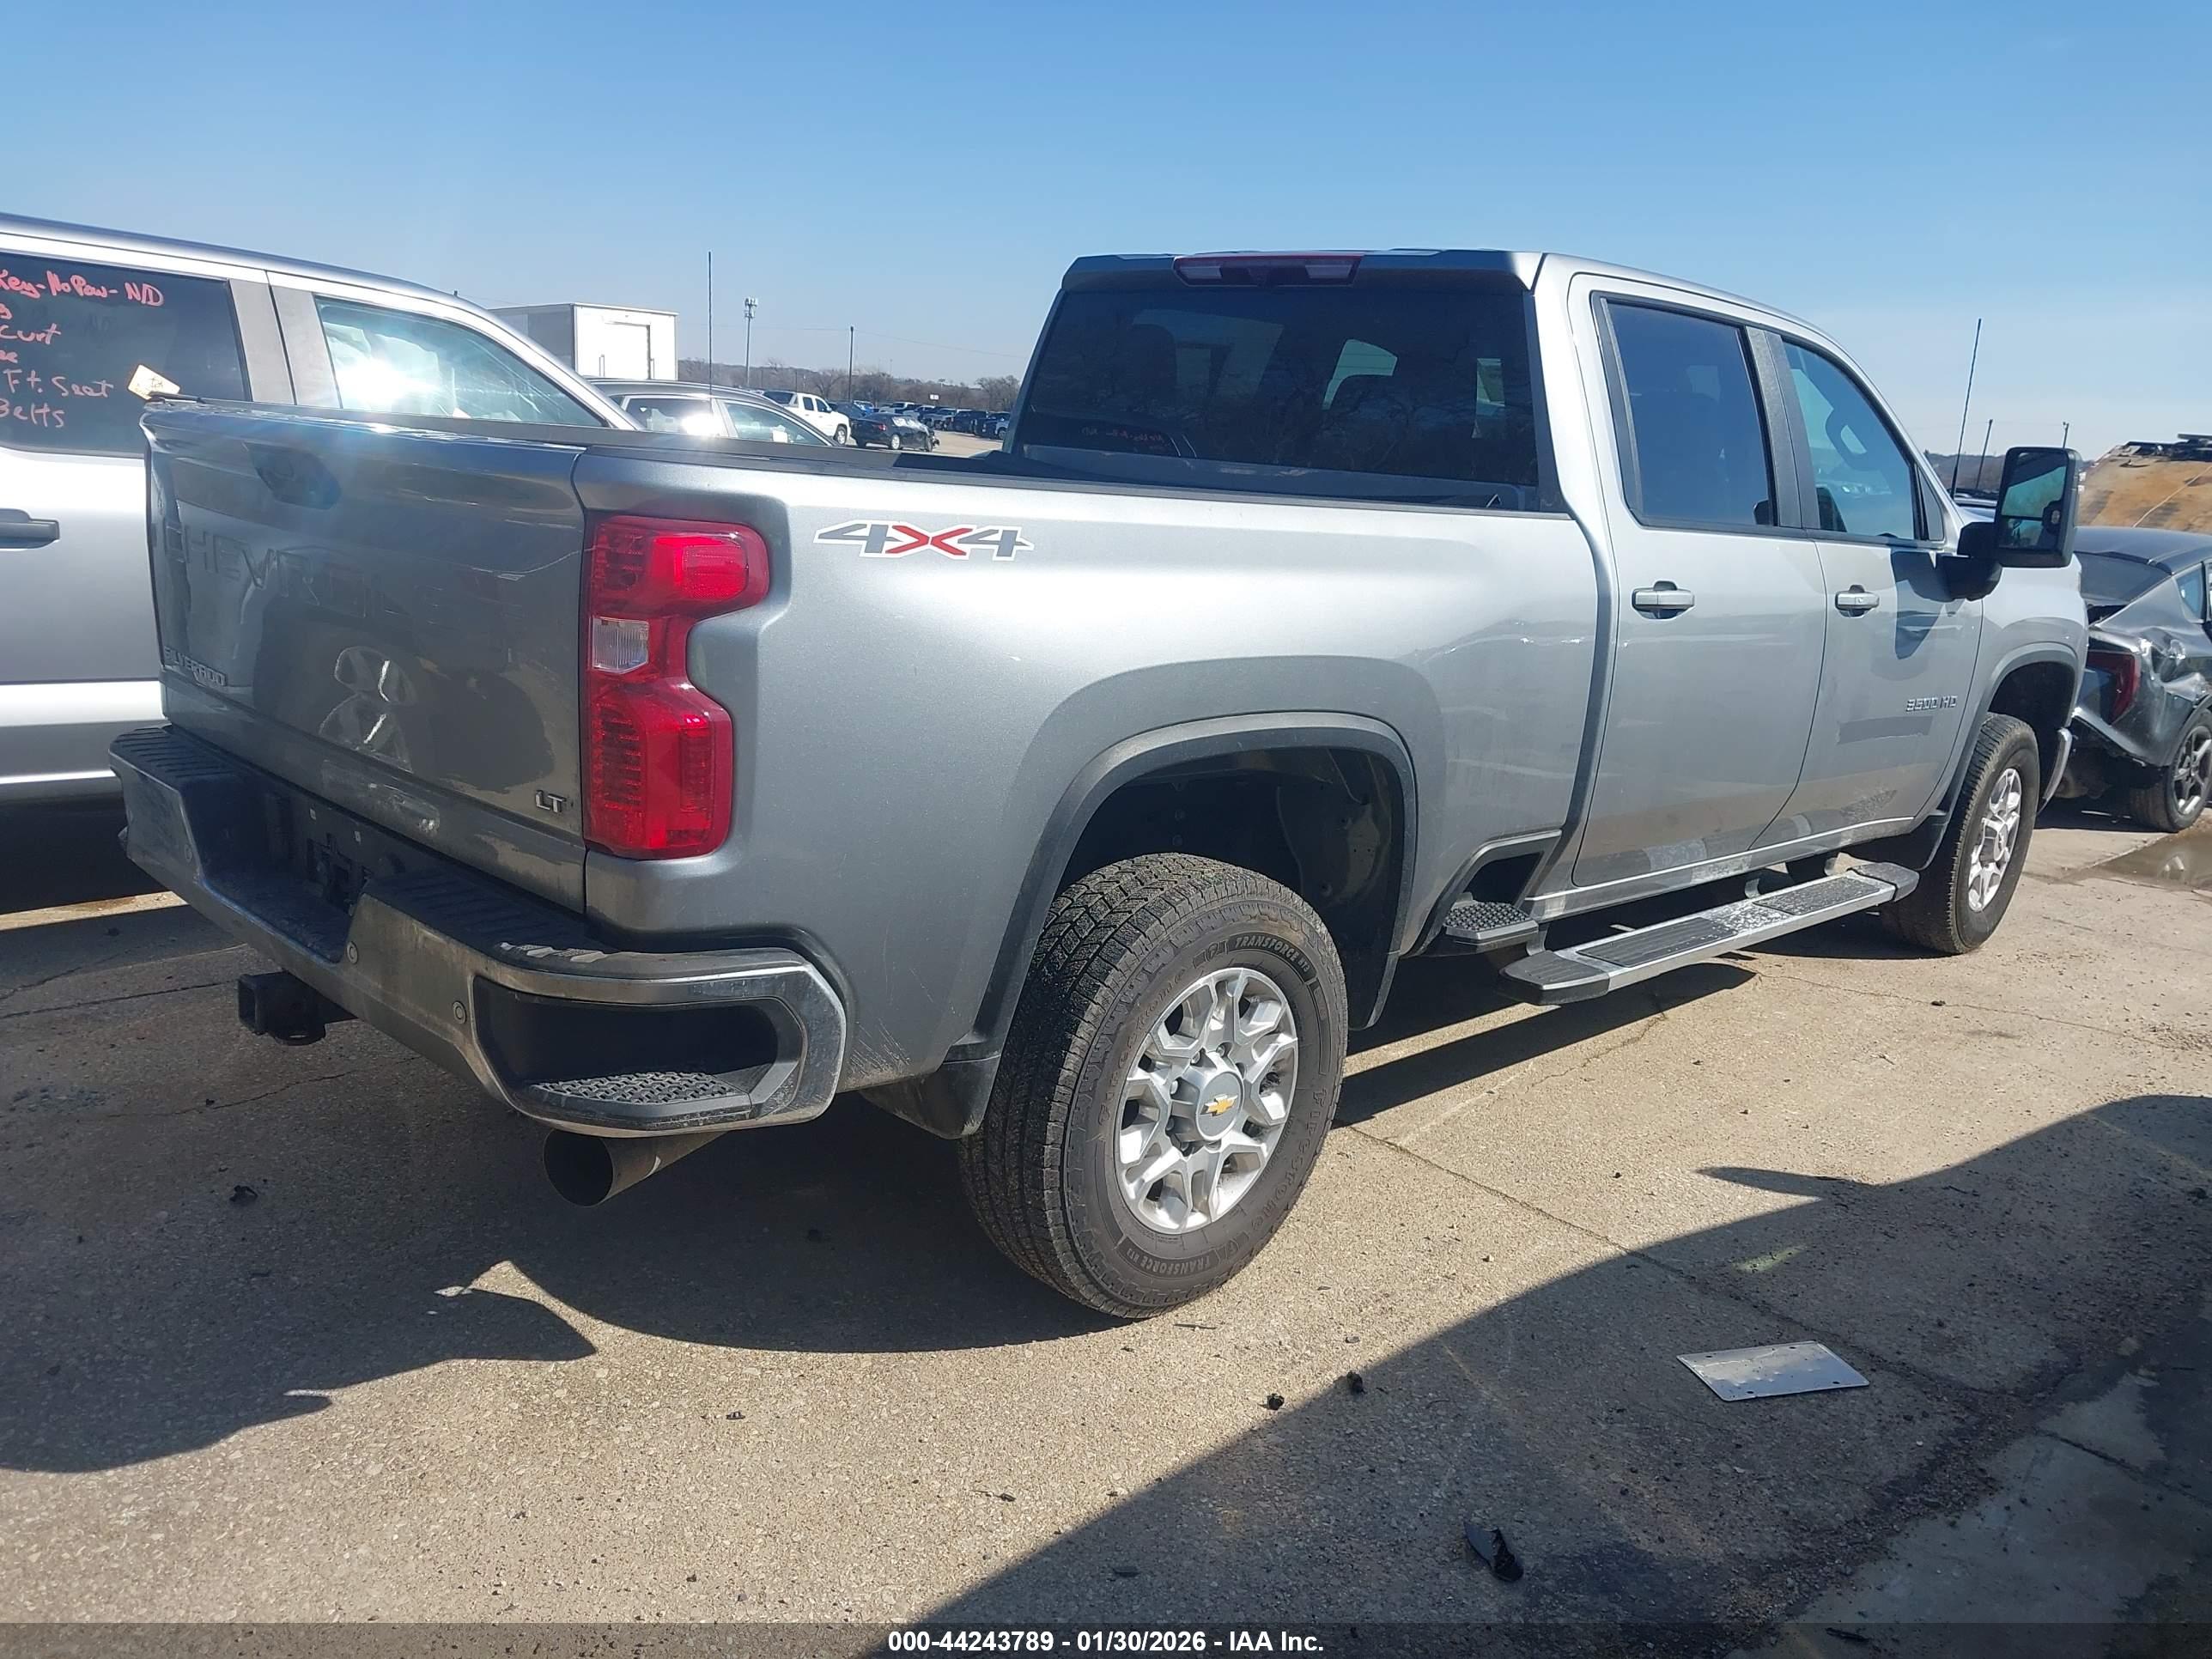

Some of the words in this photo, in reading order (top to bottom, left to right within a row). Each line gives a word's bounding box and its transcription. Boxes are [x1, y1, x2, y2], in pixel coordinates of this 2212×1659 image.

[125, 282, 164, 306] ND
[164, 646, 227, 688] SILVERADO
[1938, 695, 1958, 708] HD
[535, 790, 567, 813] LT
[1235, 935, 1299, 961] TRANSFORCE
[1139, 1254, 1210, 1276] TRANSFORCE
